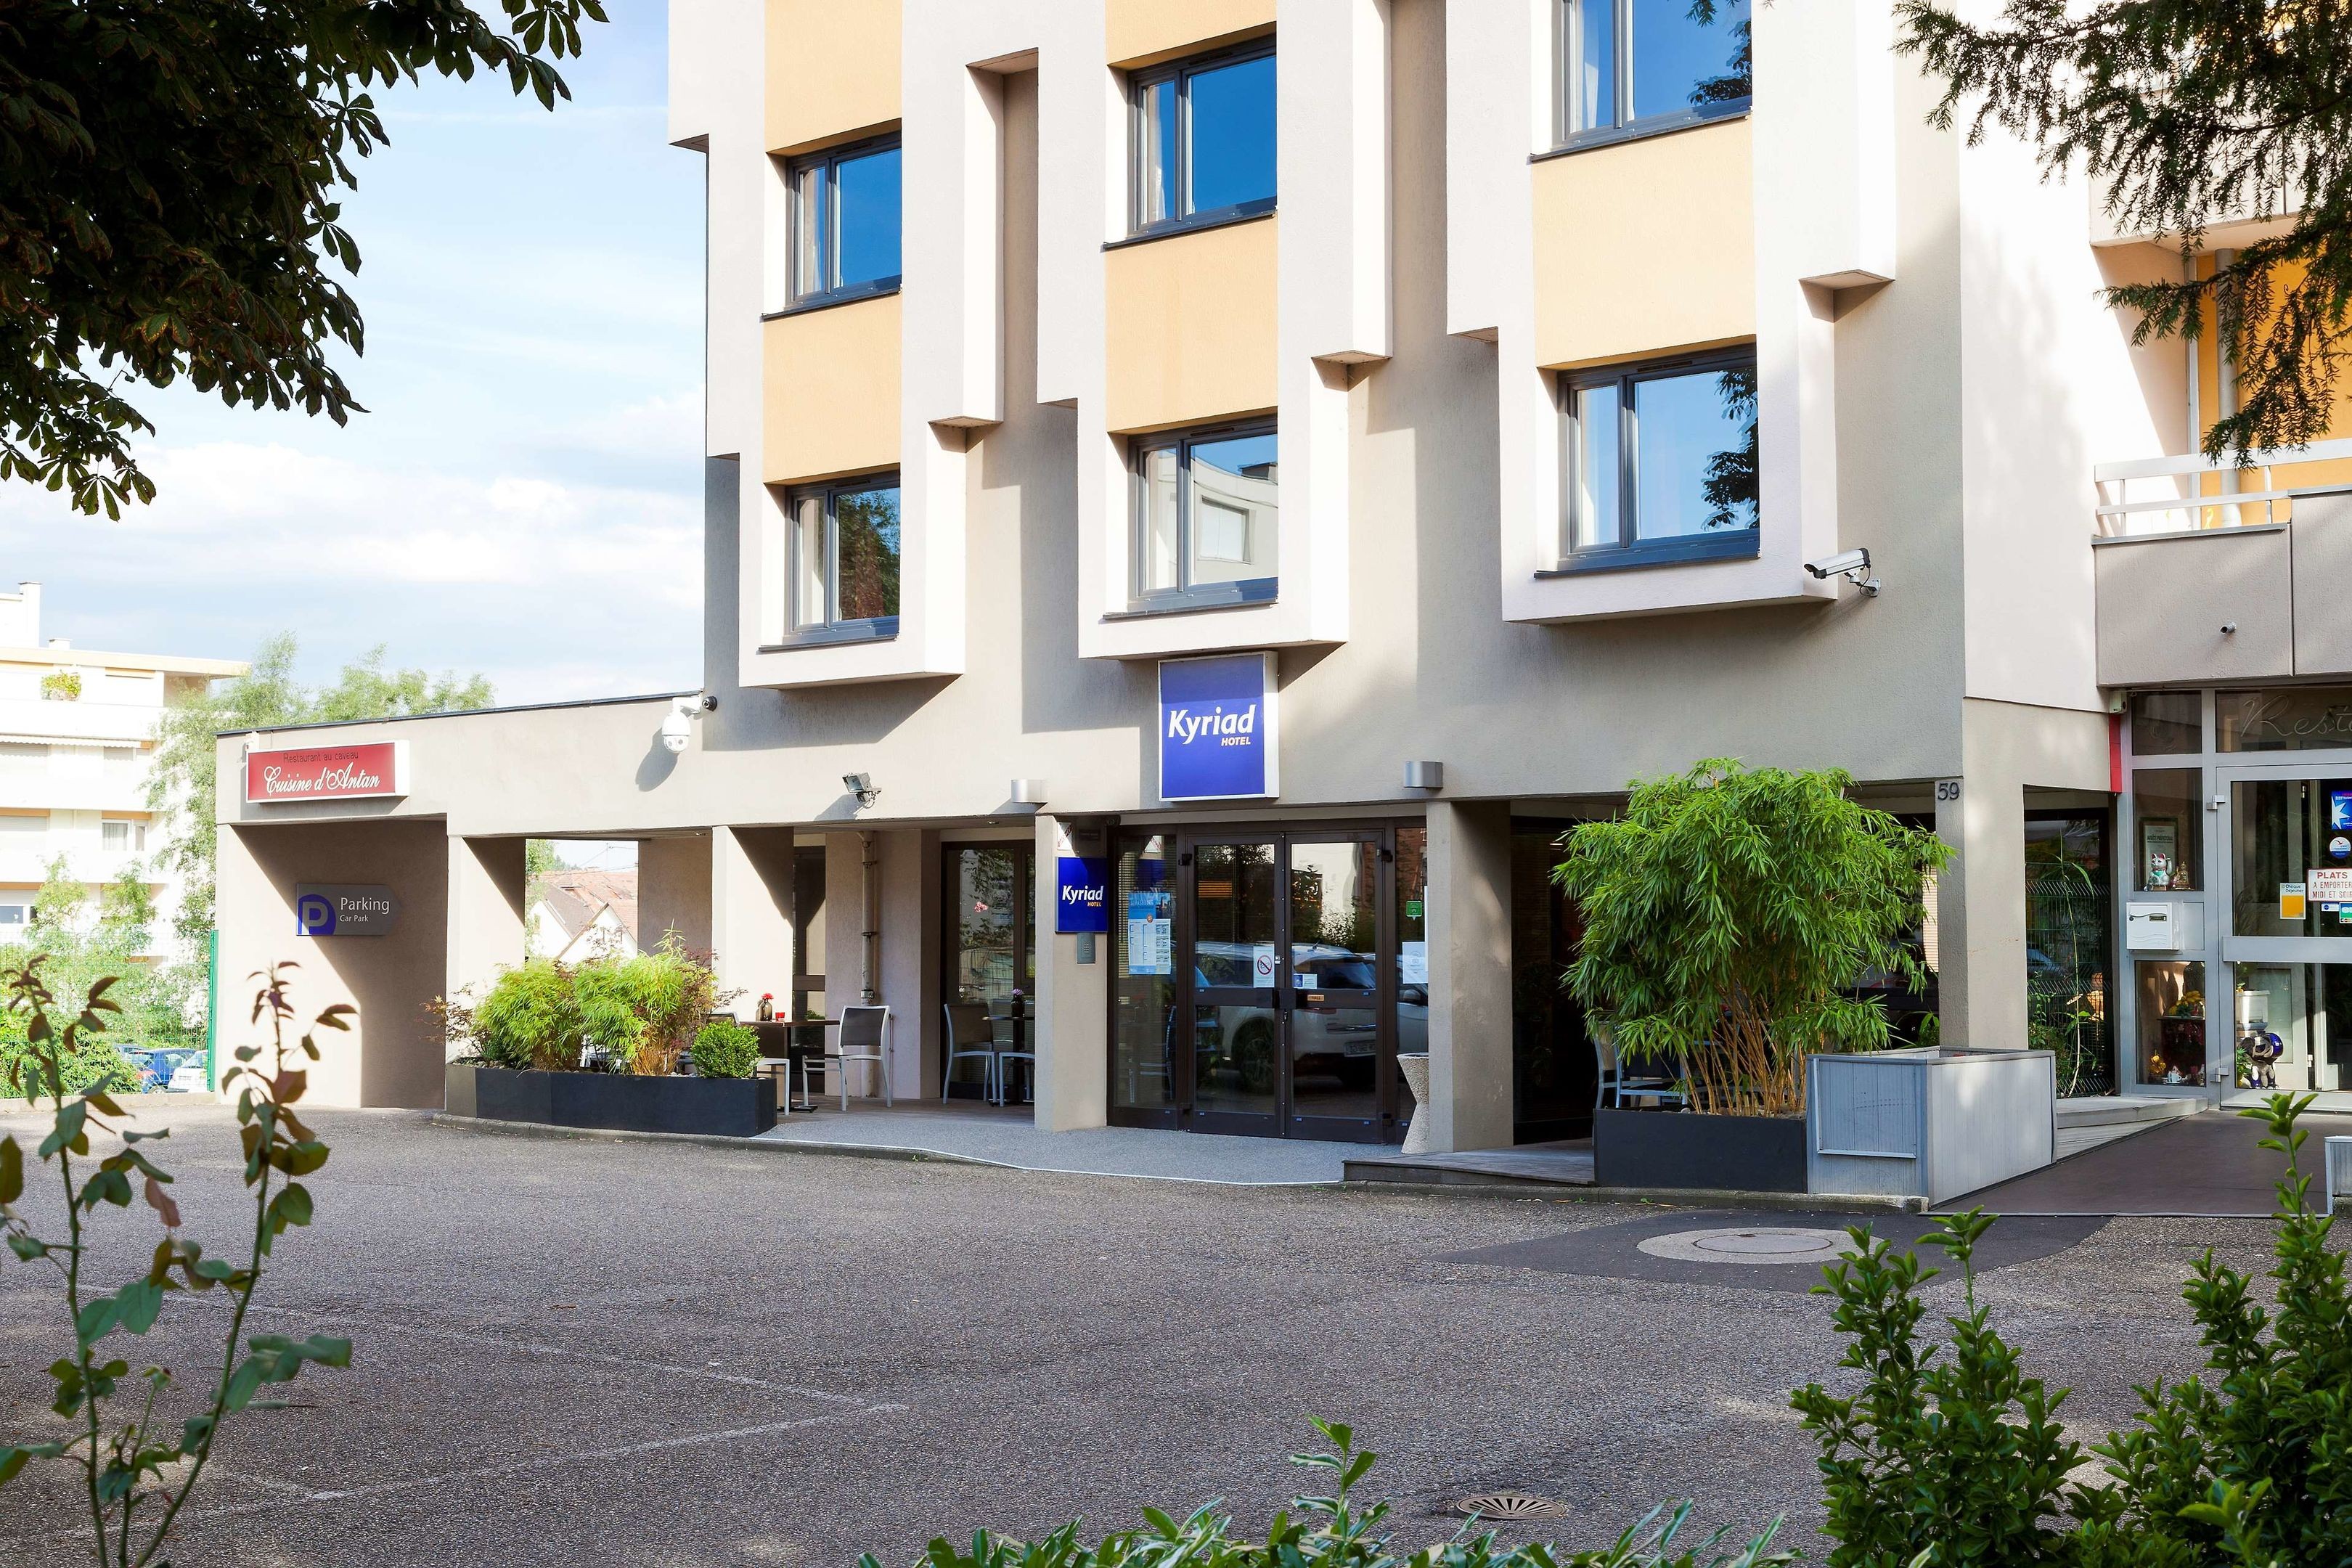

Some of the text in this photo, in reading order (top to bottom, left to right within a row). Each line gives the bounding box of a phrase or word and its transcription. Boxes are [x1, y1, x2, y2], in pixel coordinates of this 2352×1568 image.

[1168, 704, 1257, 745] Kyriad
[2240, 694, 2352, 737] Rest
[1221, 736, 1251, 746] HOTEL
[283, 753, 321, 763] Restaurant
[335, 751, 359, 760] caveau
[264, 761, 380, 796] Cuisine d'Antan
[1937, 782, 1960, 800] 59
[1062, 885, 1104, 905] Kyriad
[340, 897, 390, 915] Parking
